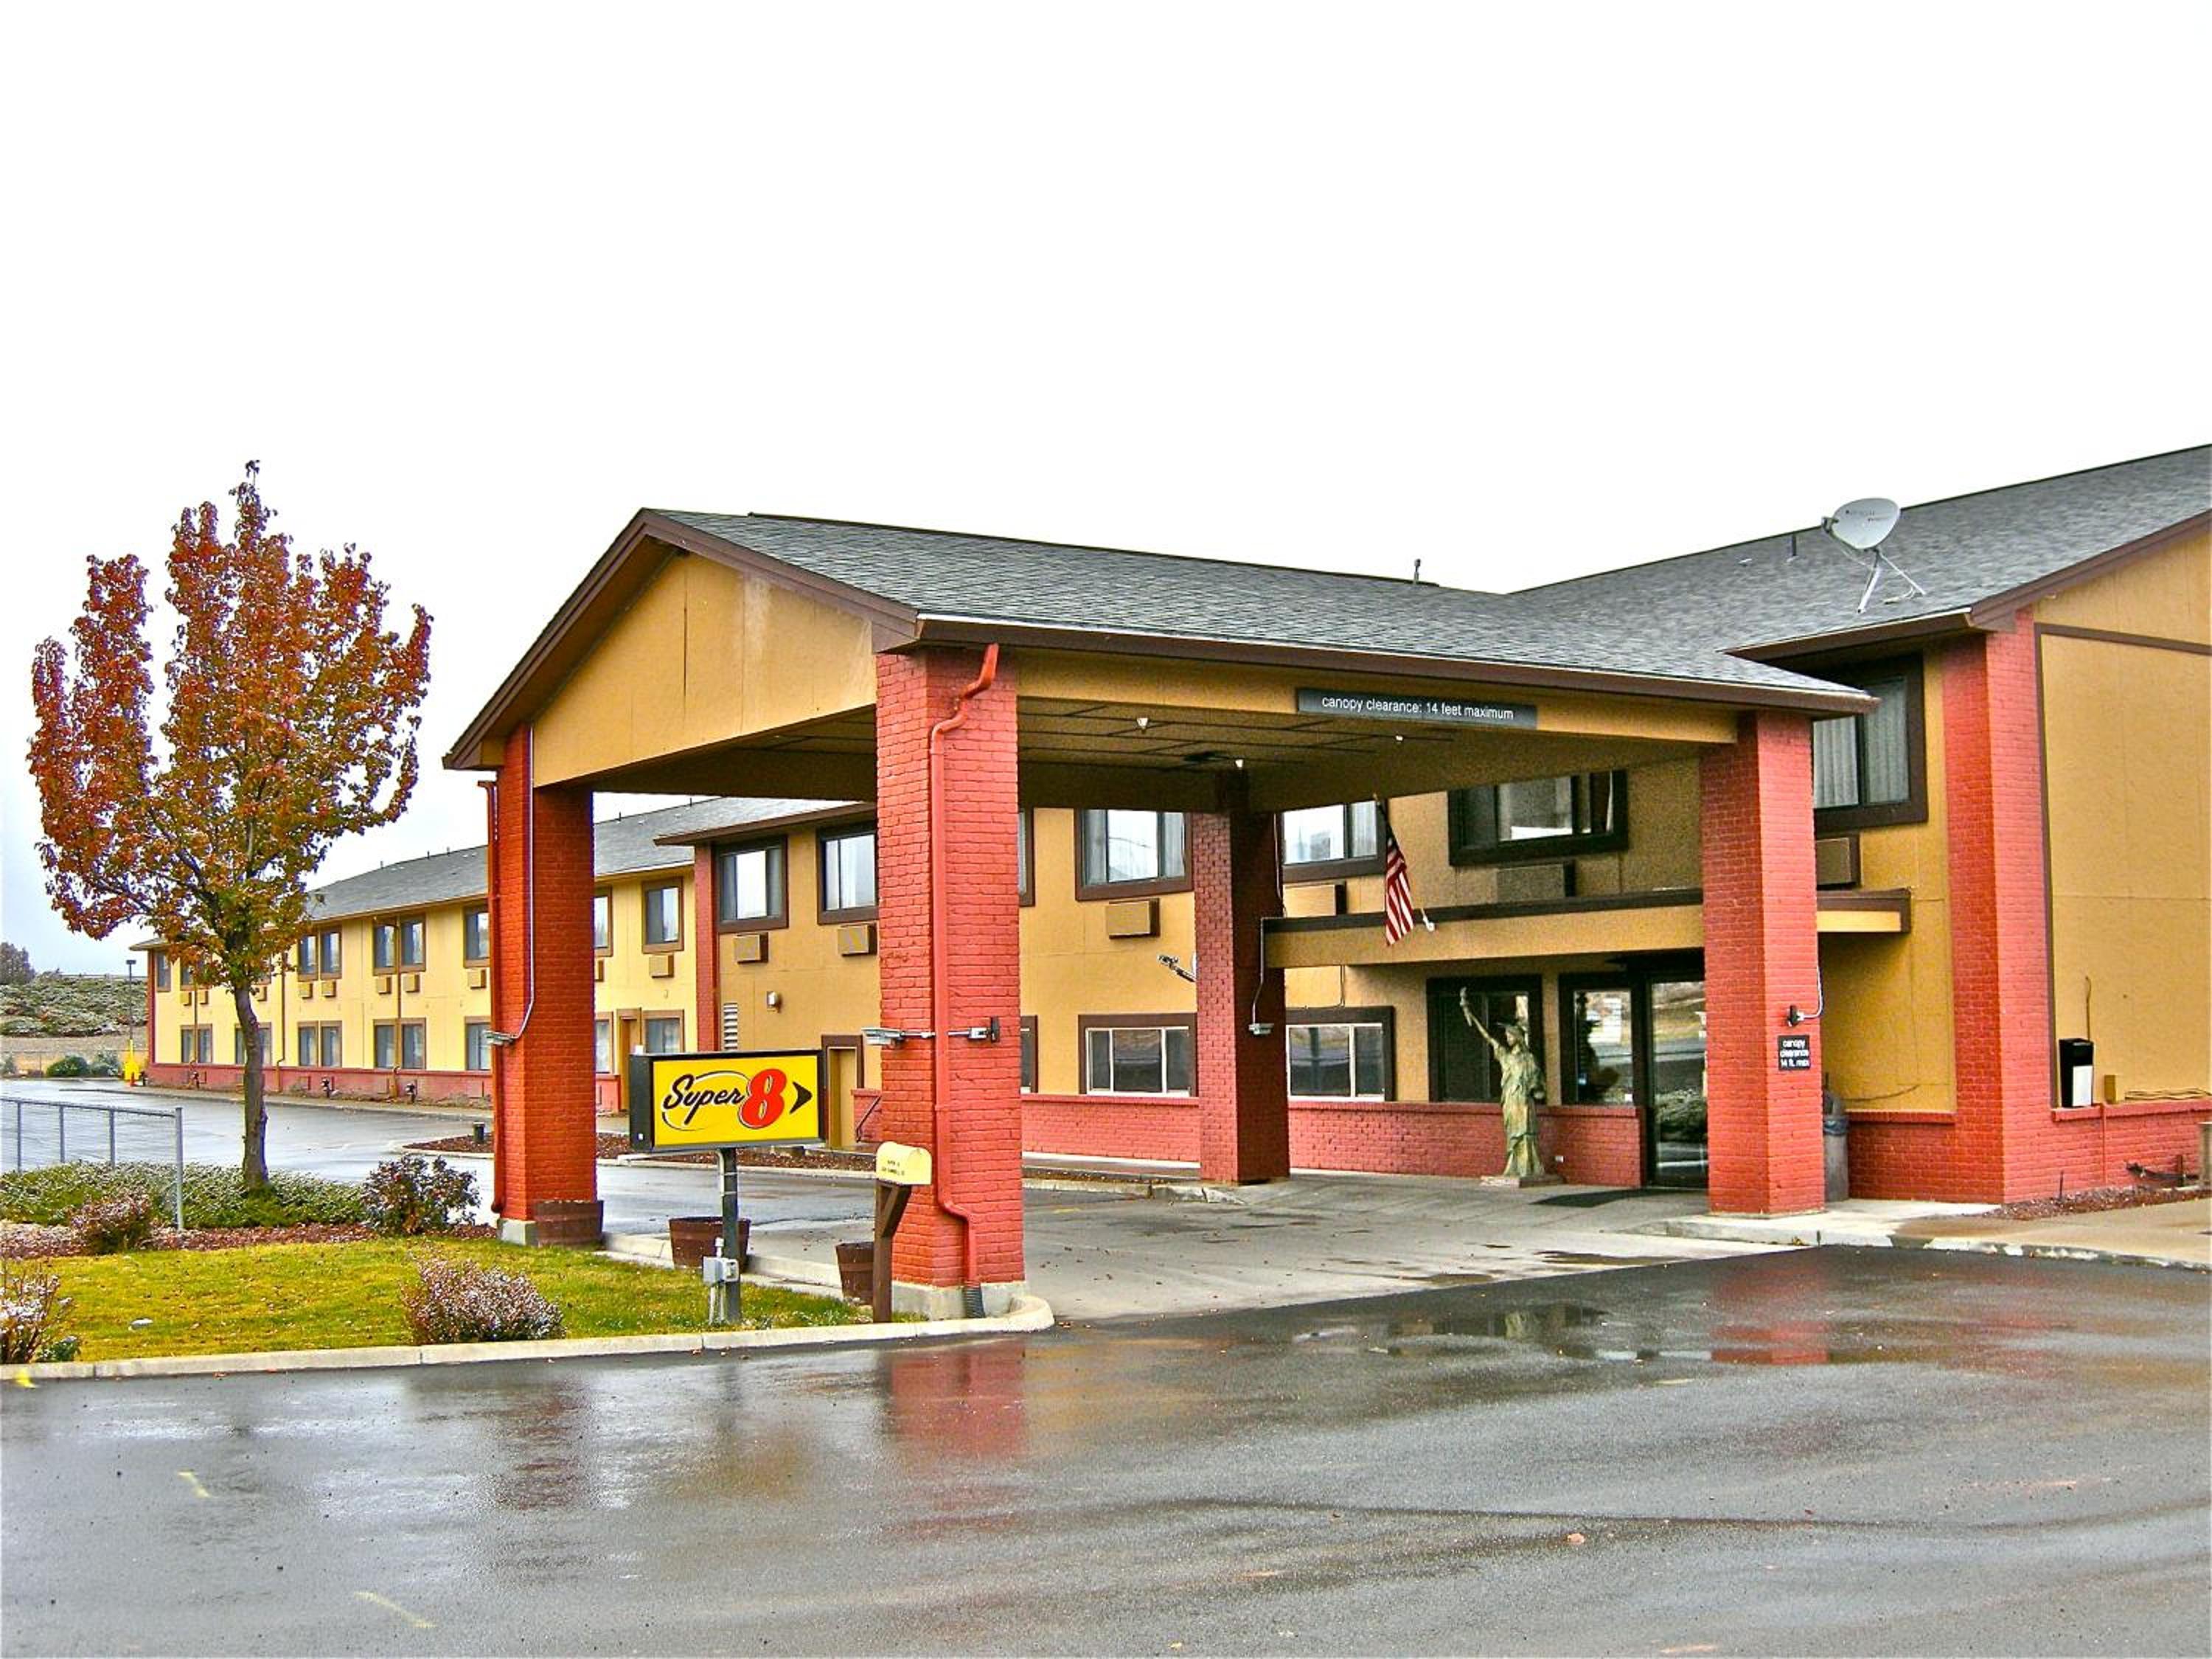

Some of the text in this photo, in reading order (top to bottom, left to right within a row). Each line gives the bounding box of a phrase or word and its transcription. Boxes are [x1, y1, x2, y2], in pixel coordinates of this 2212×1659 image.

[1321, 697, 1514, 720] canopy clearance: 14 feet maximum
[663, 1068, 787, 1129] Super 8
